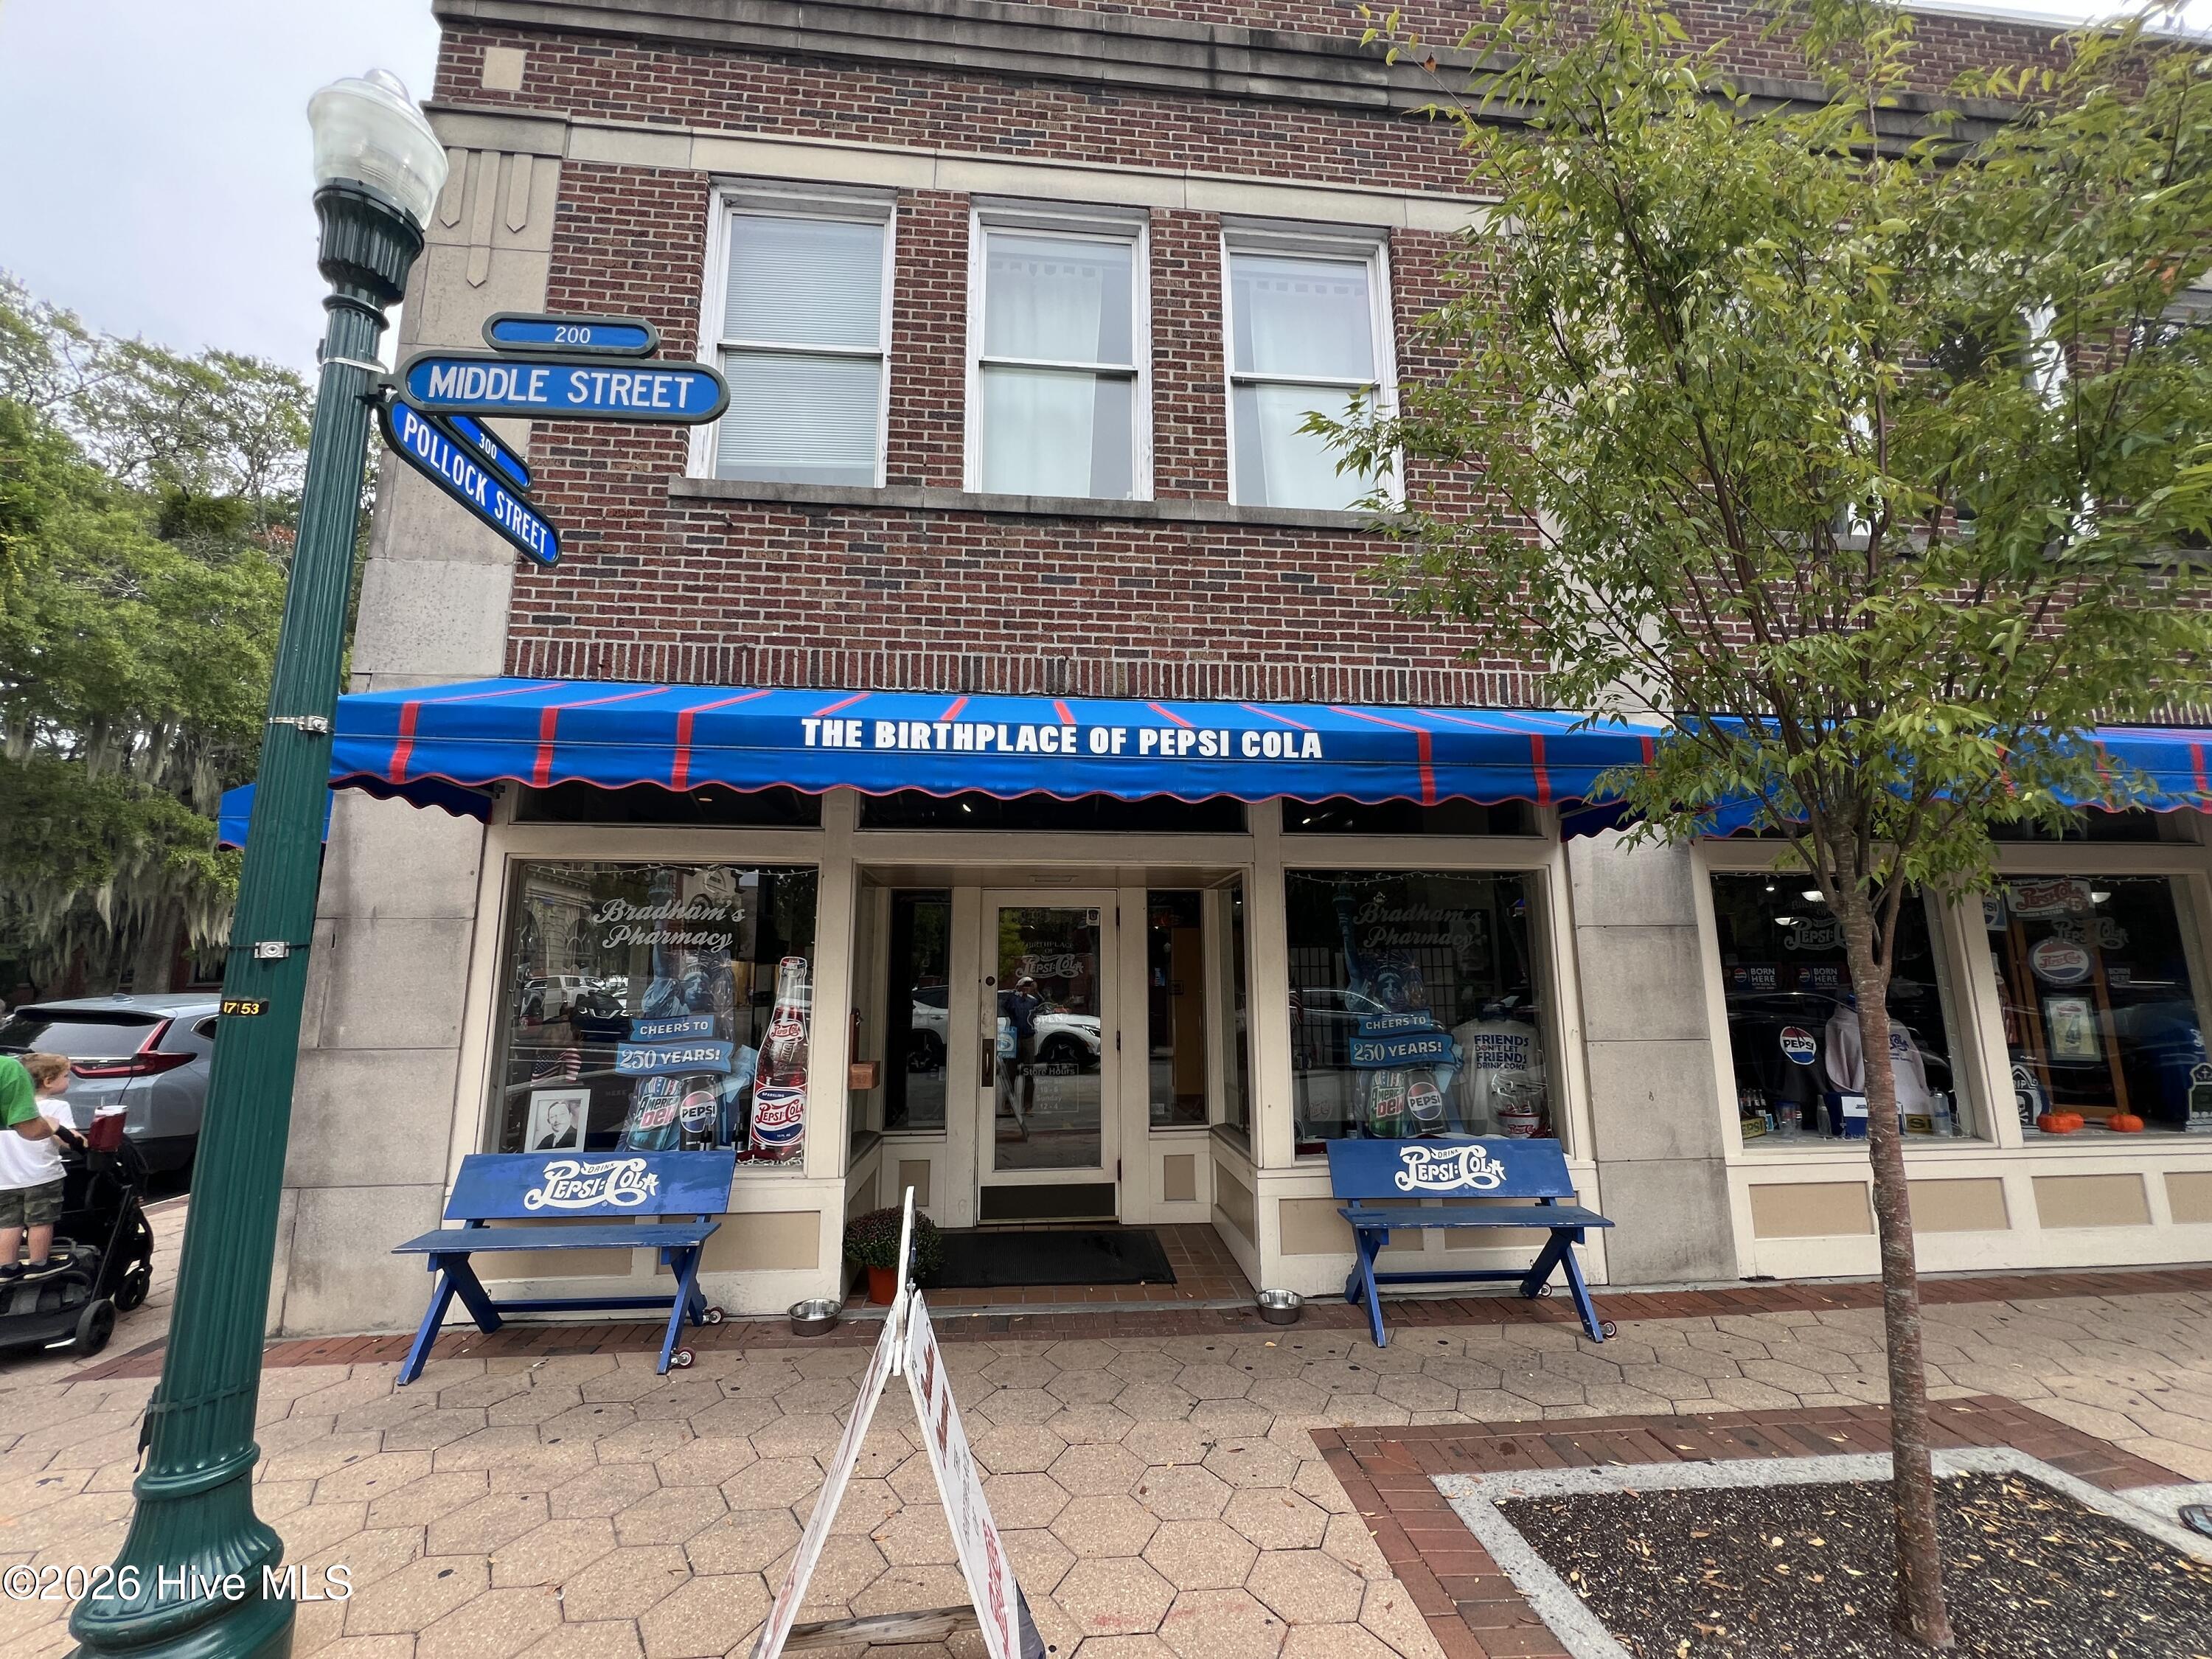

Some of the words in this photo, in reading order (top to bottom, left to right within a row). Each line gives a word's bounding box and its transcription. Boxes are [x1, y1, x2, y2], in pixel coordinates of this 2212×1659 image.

[554, 326, 591, 344] 200
[428, 365, 549, 403] MIDDLE
[567, 371, 695, 408] STREET
[479, 433, 497, 460] 300
[403, 412, 487, 507] POLLOCK
[494, 490, 547, 557] STREET
[801, 719, 862, 748] THE
[875, 720, 1077, 754] BIRTHPLACE
[1091, 726, 1125, 754] OF
[1140, 727, 1229, 757] PEPSI
[1242, 730, 1322, 758] COLA
[593, 897, 745, 925] Bradham's
[1354, 902, 1481, 925] Bradham's
[602, 924, 733, 953] Pharmacy
[1363, 925, 1476, 951] Pharmacy
[639, 1021, 691, 1036] CHEERS
[695, 1020, 709, 1032] TO
[1366, 1018, 1409, 1030] CHEERS
[1412, 1016, 1427, 1026] TO
[1474, 1034, 1528, 1046] FRIENDS
[1783, 1039, 1814, 1050] PEPSI
[619, 1048, 657, 1070] 250
[661, 1048, 720, 1065] YEARS!
[1353, 1043, 1385, 1062] 250
[1388, 1041, 1442, 1057] YEARS!
[1475, 1051, 1527, 1063] FRIENDS
[1023, 1067, 1047, 1075] Store
[1049, 1067, 1075, 1075] Hours
[1505, 1062, 1526, 1071] COKE
[1409, 1095, 1440, 1107] PEPSI
[682, 1106, 715, 1118] PEPSI
[1438, 1149, 1458, 1158] DRINK
[588, 1163, 614, 1174] DRINK
